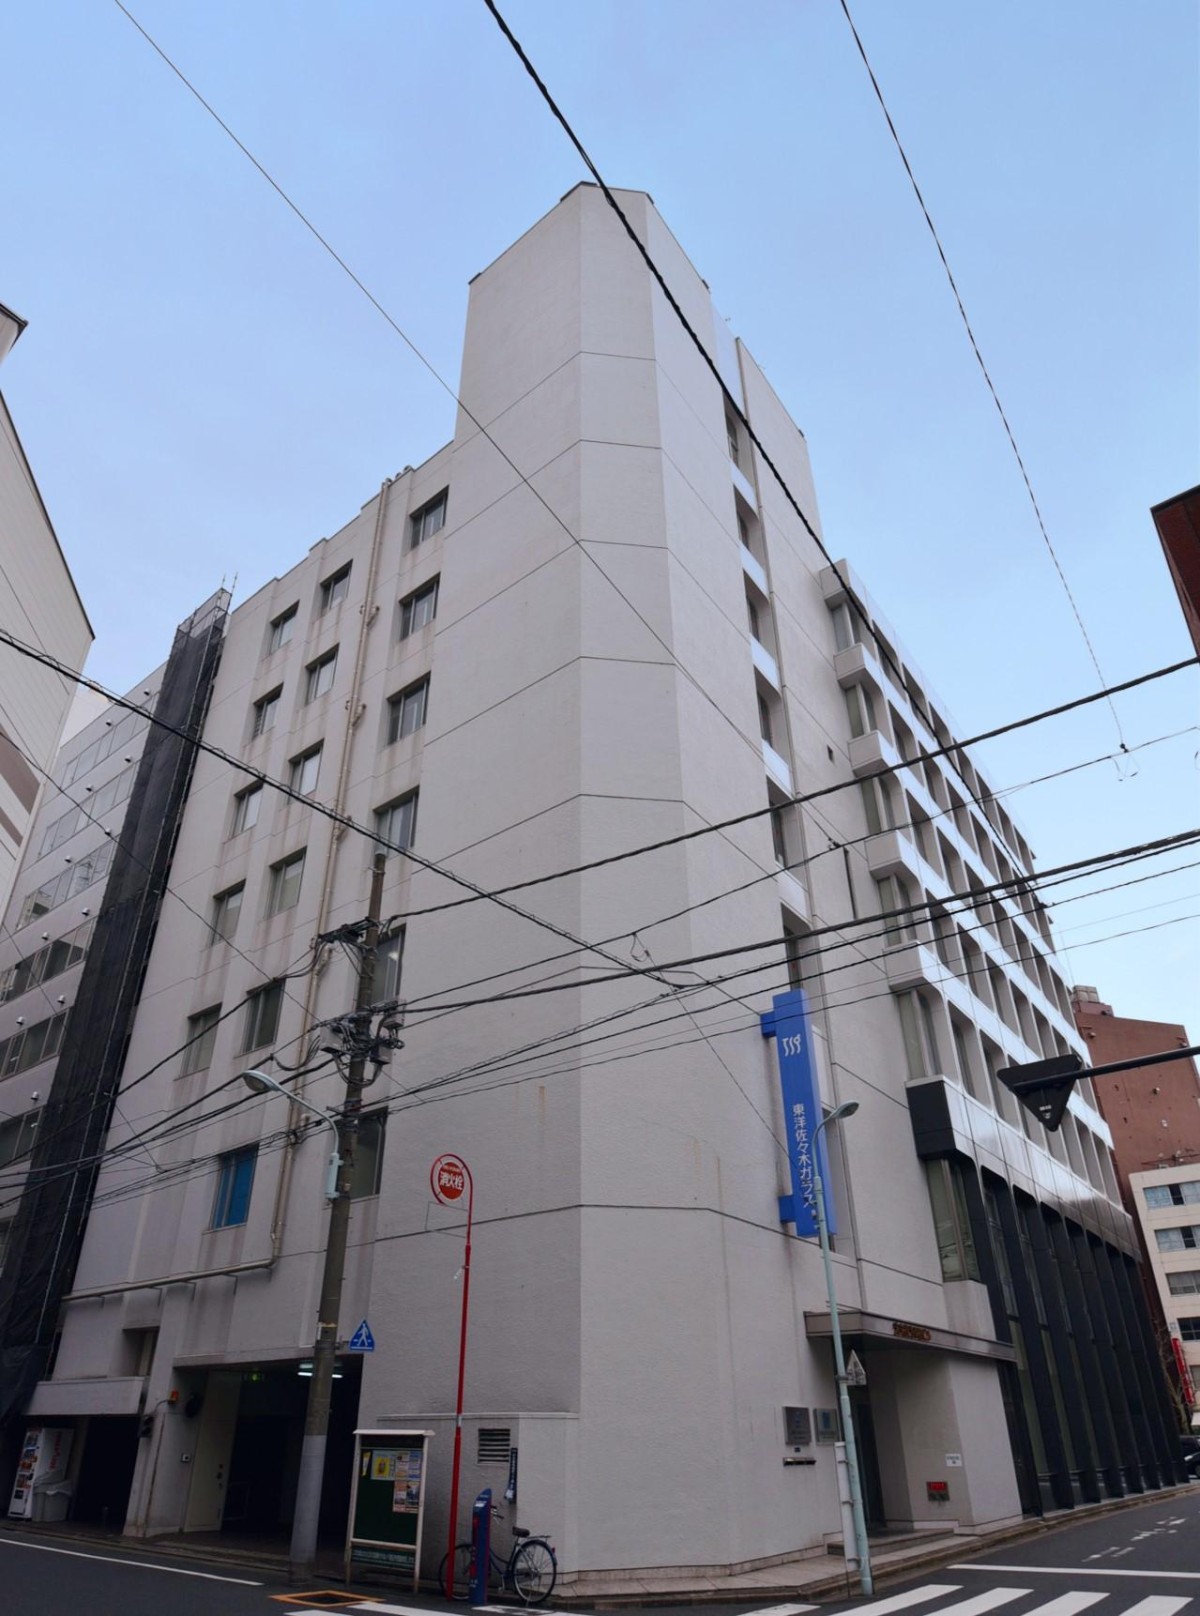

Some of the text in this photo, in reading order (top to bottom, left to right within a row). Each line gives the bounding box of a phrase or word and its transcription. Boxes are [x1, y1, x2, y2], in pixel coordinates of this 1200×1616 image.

[792, 1103, 814, 1209] 東洋佐々木ガラス
